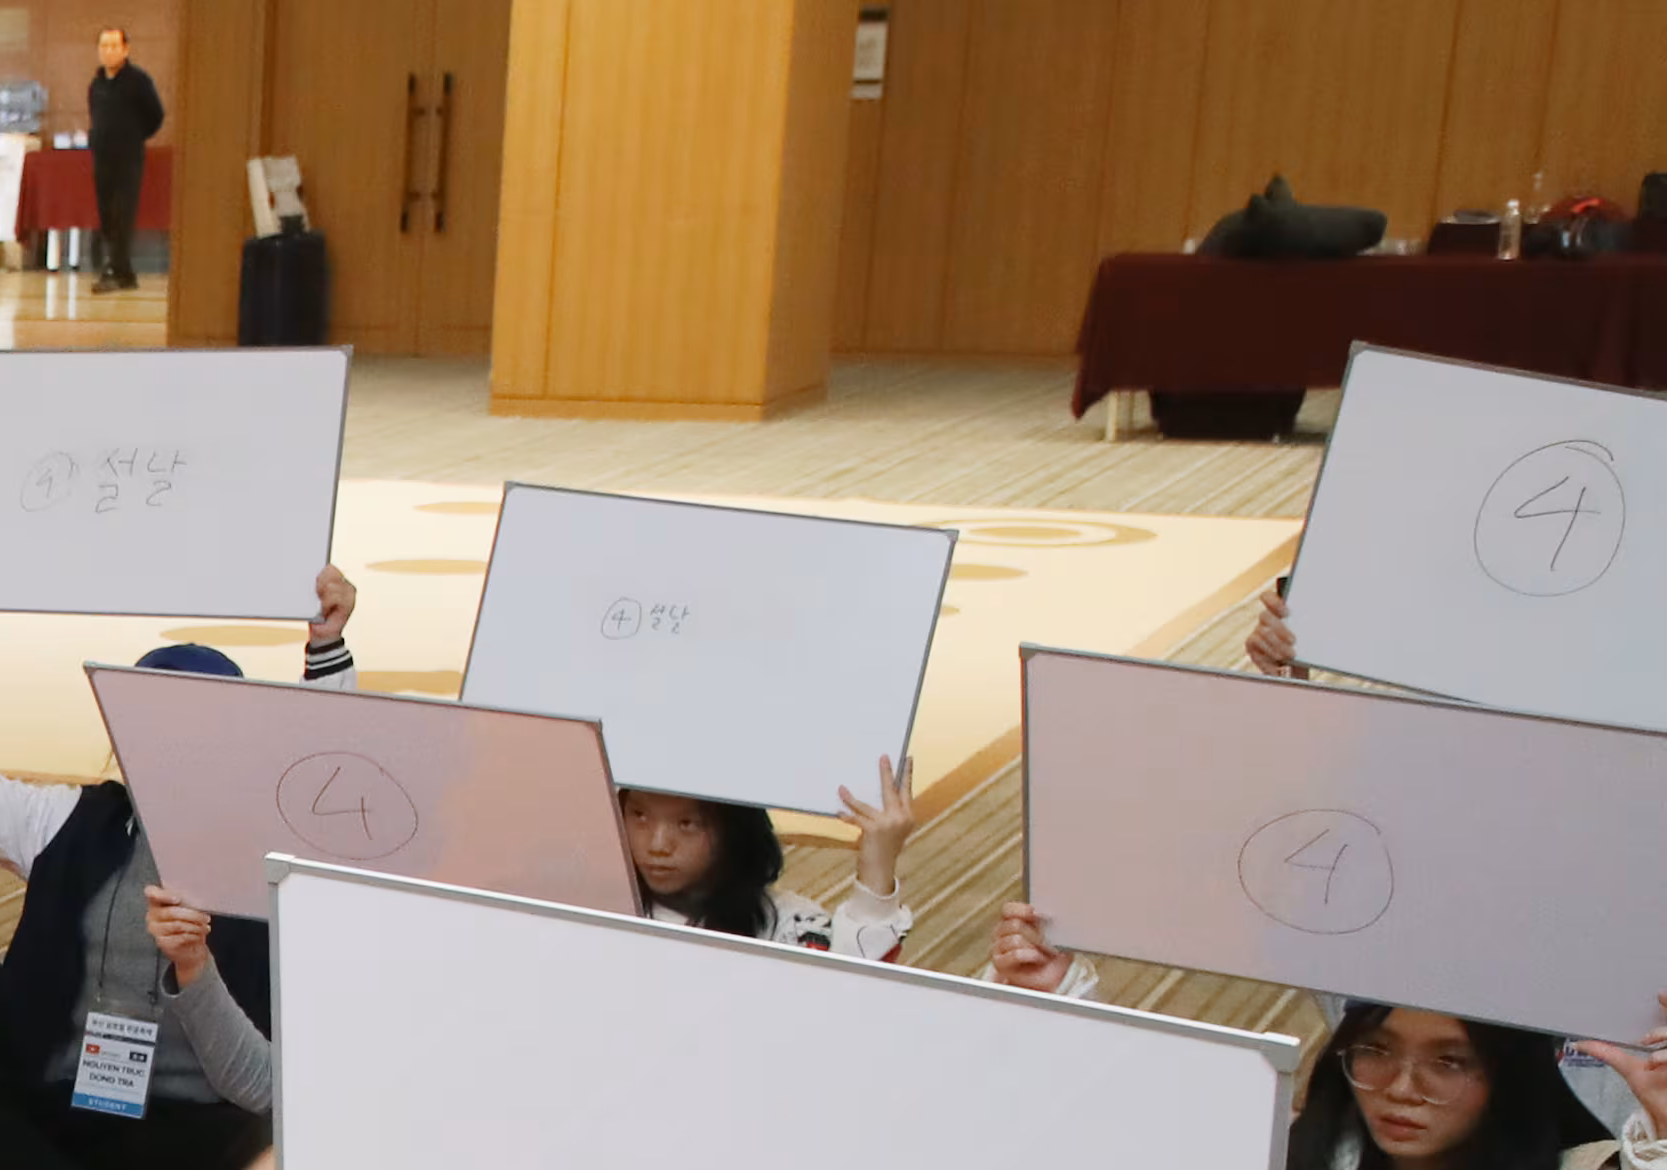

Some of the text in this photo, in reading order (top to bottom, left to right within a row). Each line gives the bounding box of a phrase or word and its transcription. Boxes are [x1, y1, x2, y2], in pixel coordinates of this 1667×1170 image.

[95, 446, 187, 512] 설날
[650, 602, 690, 633] 설날
[83, 1059, 120, 1073] NGUYEN
[88, 1097, 127, 1111] STUDENT
